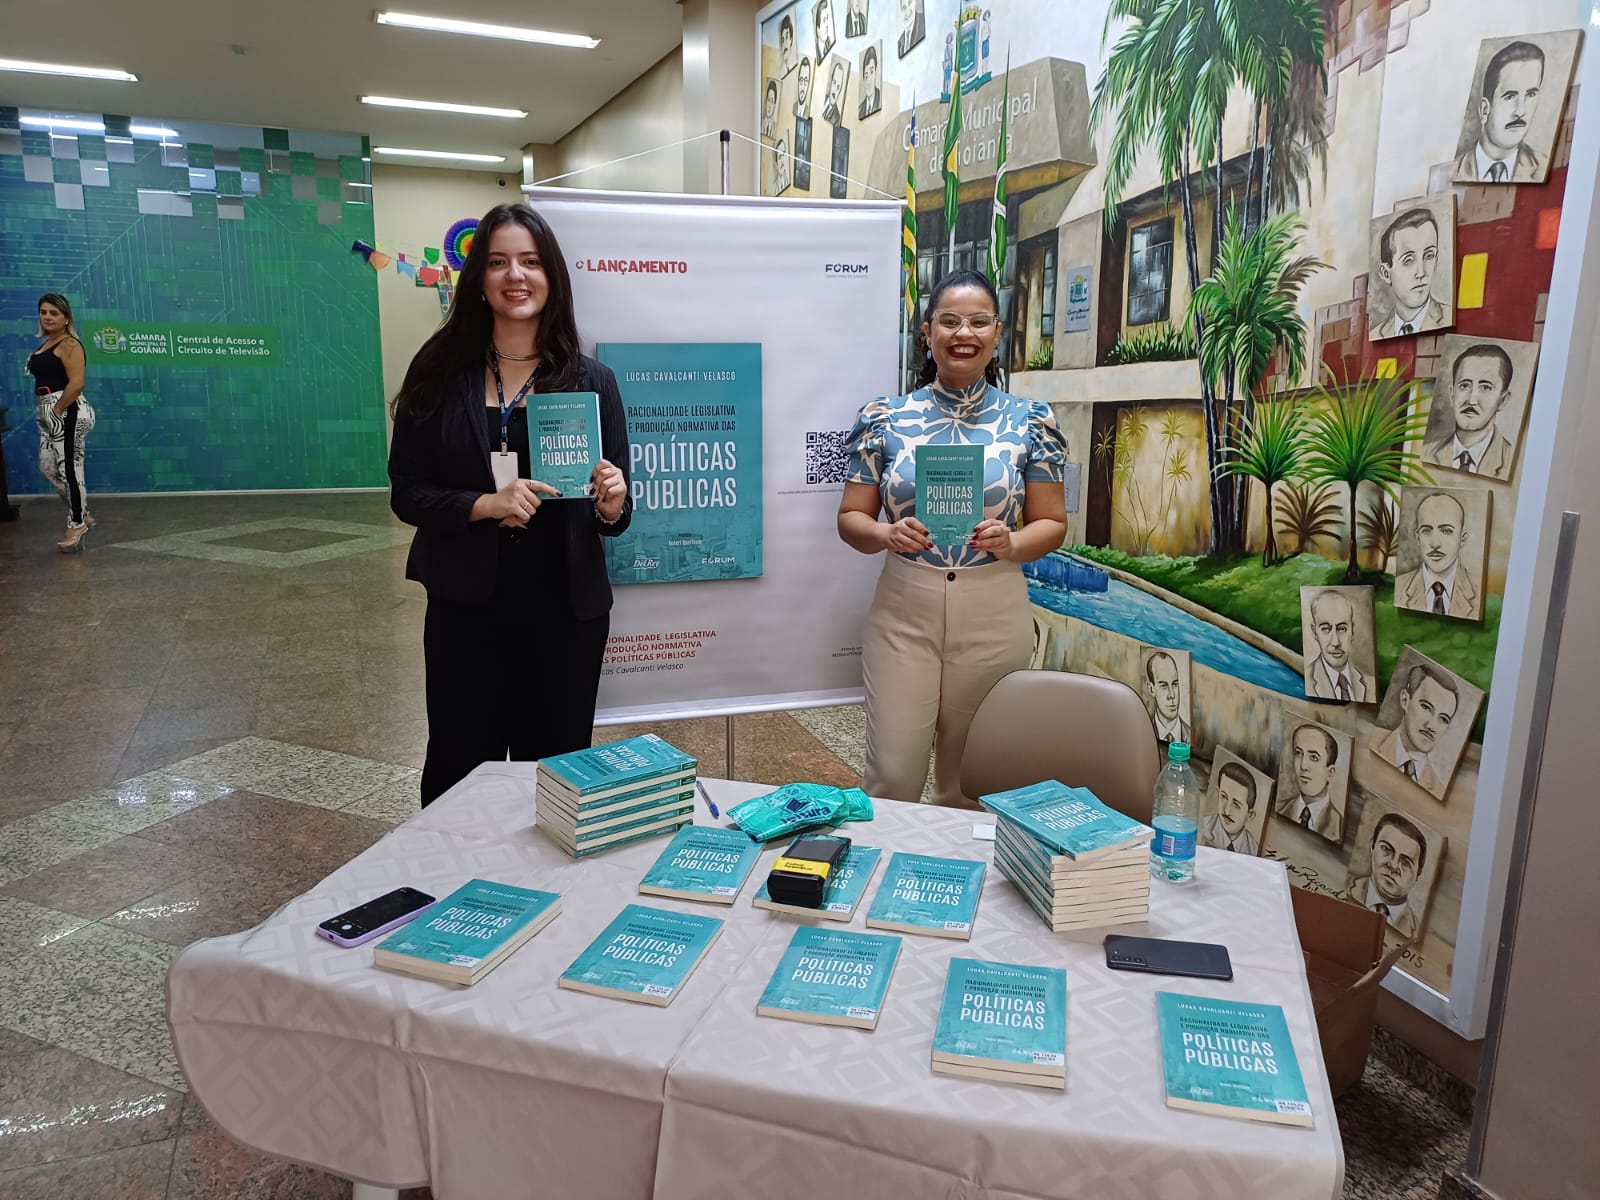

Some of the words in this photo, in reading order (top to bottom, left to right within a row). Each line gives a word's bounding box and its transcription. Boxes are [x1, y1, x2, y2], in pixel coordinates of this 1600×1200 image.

[586, 258, 688, 275] LANÇAMENTO
[129, 332, 167, 341] CÂMARA
[177, 335, 210, 344] Central
[212, 336, 224, 345] de
[226, 337, 257, 346] Acesso
[130, 345, 167, 354] GOIÂNIA
[178, 346, 213, 355] Circuito
[215, 346, 227, 355] de
[229, 347, 270, 356] Televisão
[625, 371, 651, 382] LUCAS
[654, 371, 700, 381] CAVALCANTI
[703, 371, 736, 381] VELASCO
[627, 405, 689, 418] RACIONALIDADE
[691, 404, 736, 417] LEGISLATIVA
[628, 422, 633, 433] E
[635, 419, 675, 436] PRODUÇÃO
[677, 420, 719, 433] NORMATIVA
[721, 420, 736, 431] DAS
[540, 432, 589, 451] POLÍTICAS
[630, 435, 737, 473] POLÍTICAS
[631, 473, 737, 511] PÚBLICAS
[926, 482, 973, 499] POLÍTICAS
[606, 633, 661, 645] IONALIDADE
[665, 630, 717, 641] LEGISLATIVA
[606, 643, 649, 654] RODUÇÃO
[651, 640, 703, 651] NORMATIVA
[611, 652, 655, 664] POLÍTICAS
[656, 650, 697, 661] PÚBLICAS
[601, 667, 614, 676] cas
[616, 664, 656, 675] Cavalcanti
[657, 662, 684, 672] Velasco
[677, 848, 740, 864] POLÍTICAS
[896, 877, 964, 895] POLÍTICAS
[441, 907, 513, 929] POLÍTICAS
[612, 933, 687, 956] POLÍTICAS
[1398, 945, 1425, 969] 015
[797, 956, 874, 976] POLÍTICAS
[962, 993, 1046, 1015] POLÍTICAS
[960, 1006, 1044, 1030] PÚBLICAS
[1183, 1031, 1275, 1057] POLÍTICAS
[1184, 1047, 1279, 1075] PÚBLICAS
